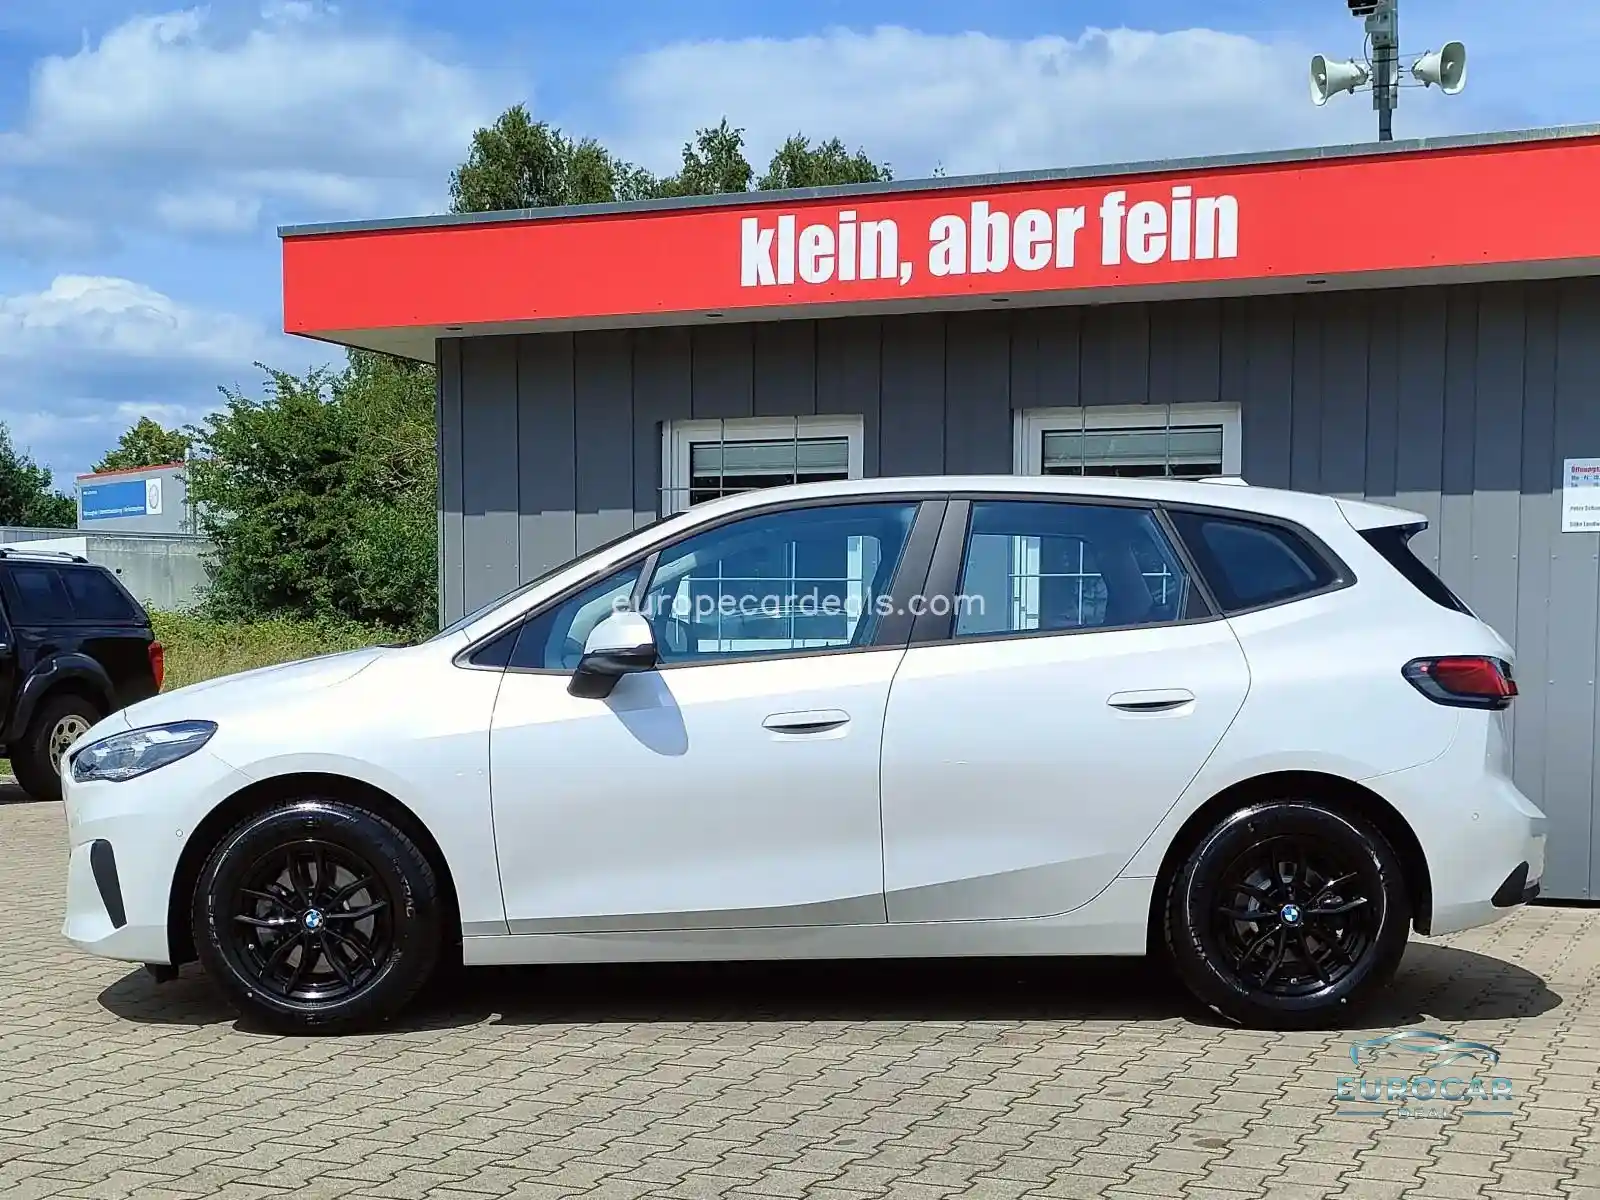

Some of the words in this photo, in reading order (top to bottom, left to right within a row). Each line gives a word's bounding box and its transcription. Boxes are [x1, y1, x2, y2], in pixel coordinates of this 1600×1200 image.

[740, 211, 913, 287] klein,
[928, 200, 1085, 276] aber
[1100, 185, 1239, 266] fein
